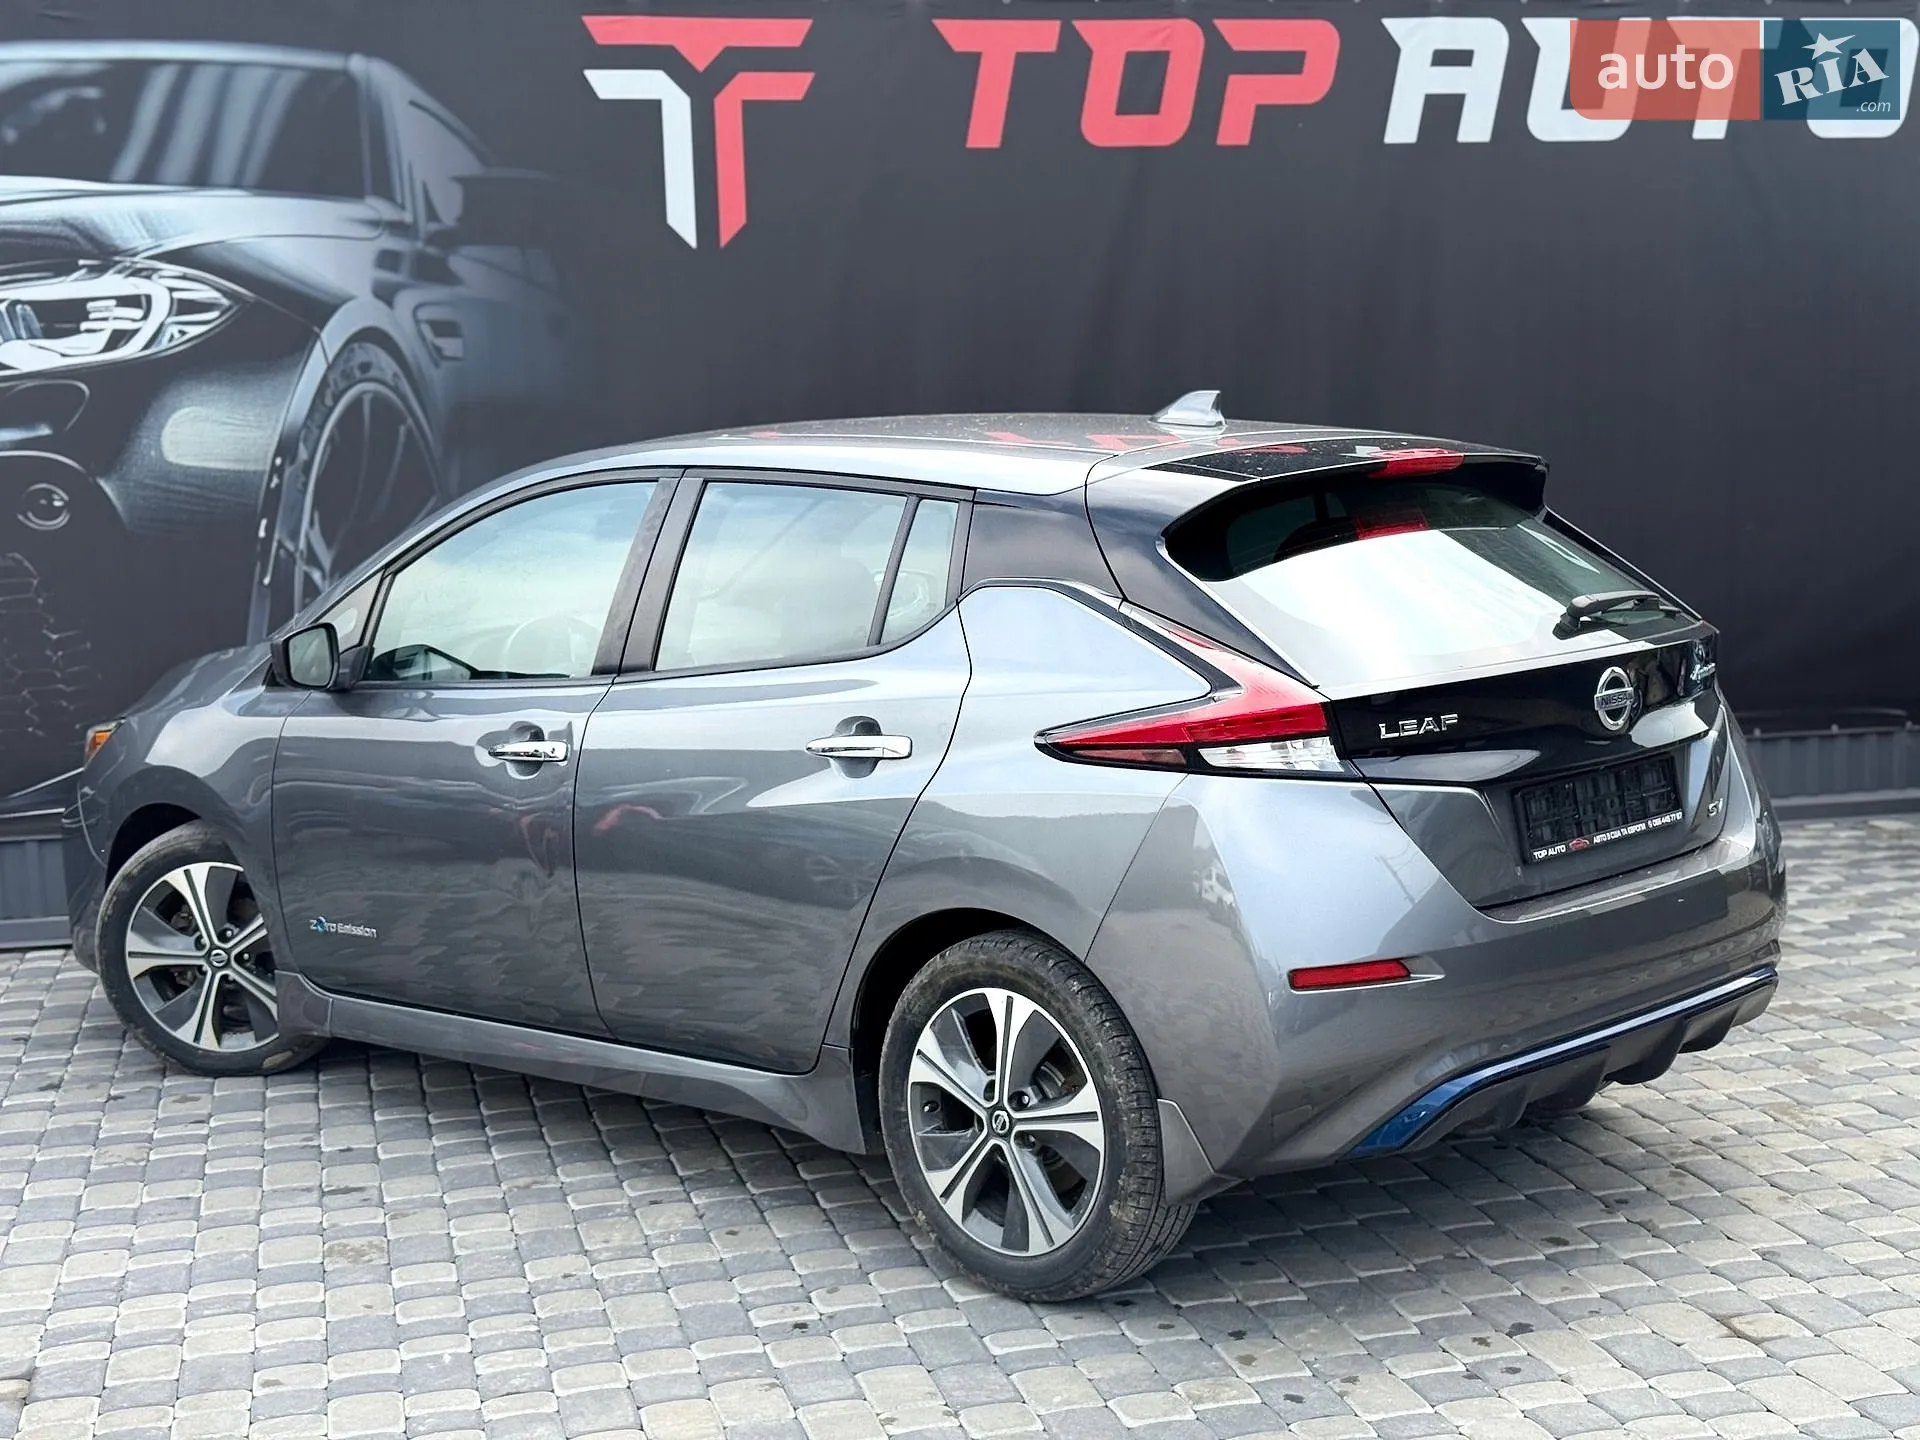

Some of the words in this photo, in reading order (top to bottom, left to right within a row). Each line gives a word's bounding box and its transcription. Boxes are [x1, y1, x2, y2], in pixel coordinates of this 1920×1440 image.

[931, 17, 1341, 149] TOP
[1380, 15, 1919, 145] AUTO
[1378, 713, 1459, 740] LEAF
[1533, 849, 1547, 860] TOP
[1547, 844, 1567, 856] AUTO
